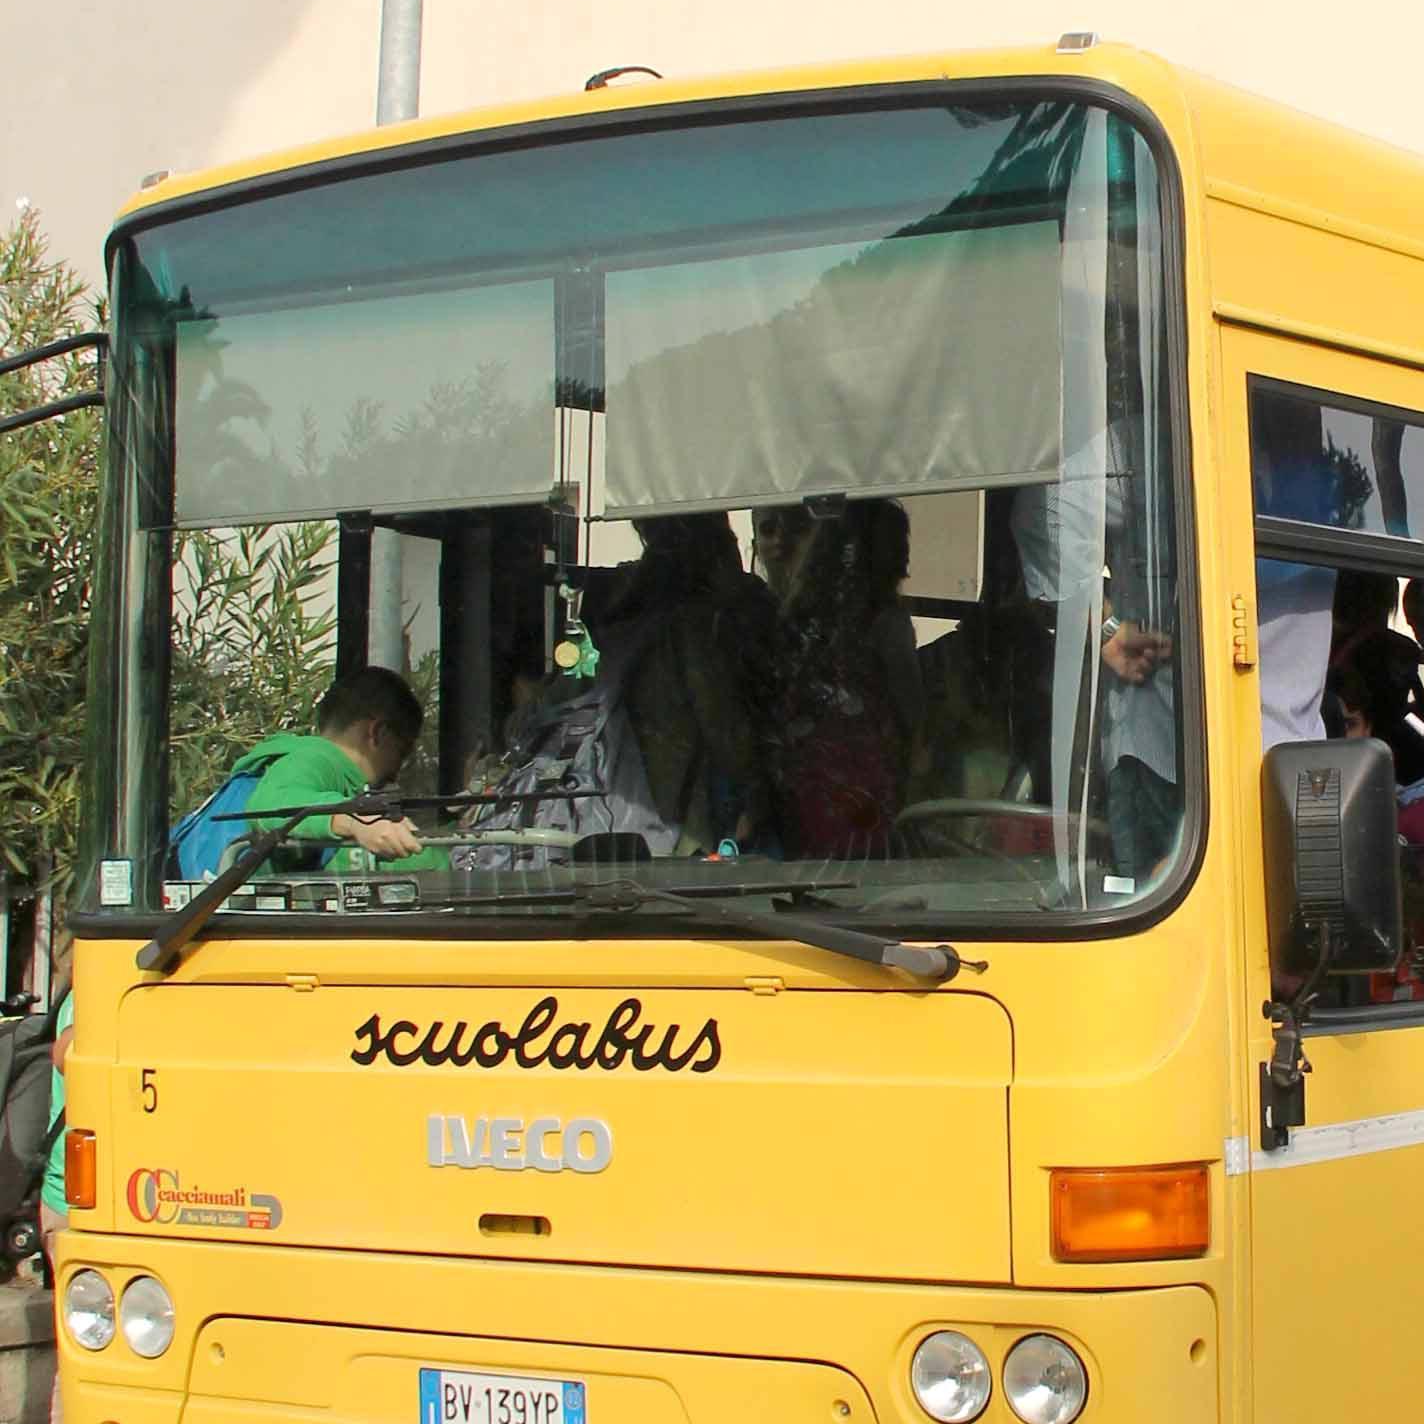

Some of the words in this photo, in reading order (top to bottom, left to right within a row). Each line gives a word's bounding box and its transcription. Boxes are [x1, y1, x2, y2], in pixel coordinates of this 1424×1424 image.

[350, 996, 722, 1073] scuolabus
[142, 1068, 158, 1114] 5
[426, 1114, 613, 1174] IVECO
[158, 1185, 246, 1207] cacciamali
